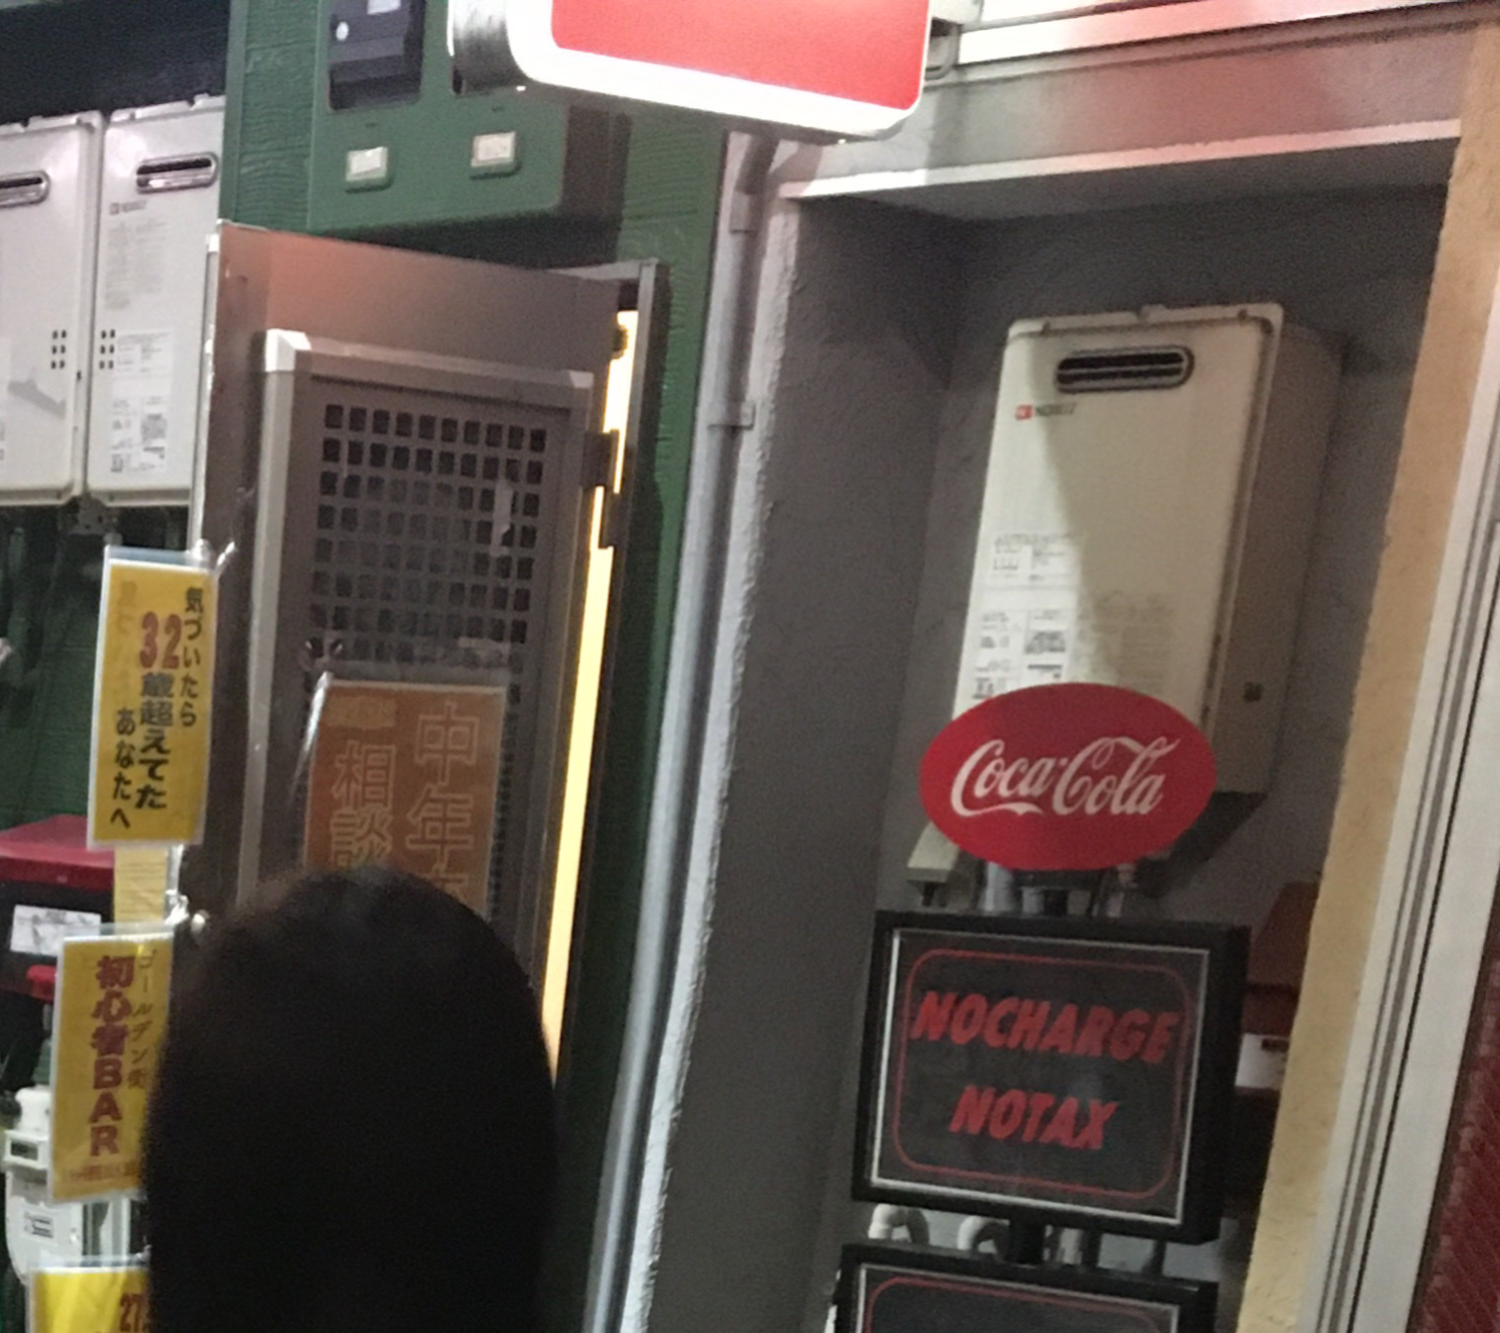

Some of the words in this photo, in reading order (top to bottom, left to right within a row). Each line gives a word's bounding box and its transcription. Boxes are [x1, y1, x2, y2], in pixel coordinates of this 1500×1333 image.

[179, 586, 205, 727] 気づいたら
[110, 707, 137, 830] あなたへ
[329, 740, 398, 872] 相談
[950, 736, 1182, 817] Coca-Cola
[88, 955, 135, 1157] 初心者BAR
[908, 990, 1180, 1064] NOCHARGE
[949, 1083, 1120, 1149] NOTAX
